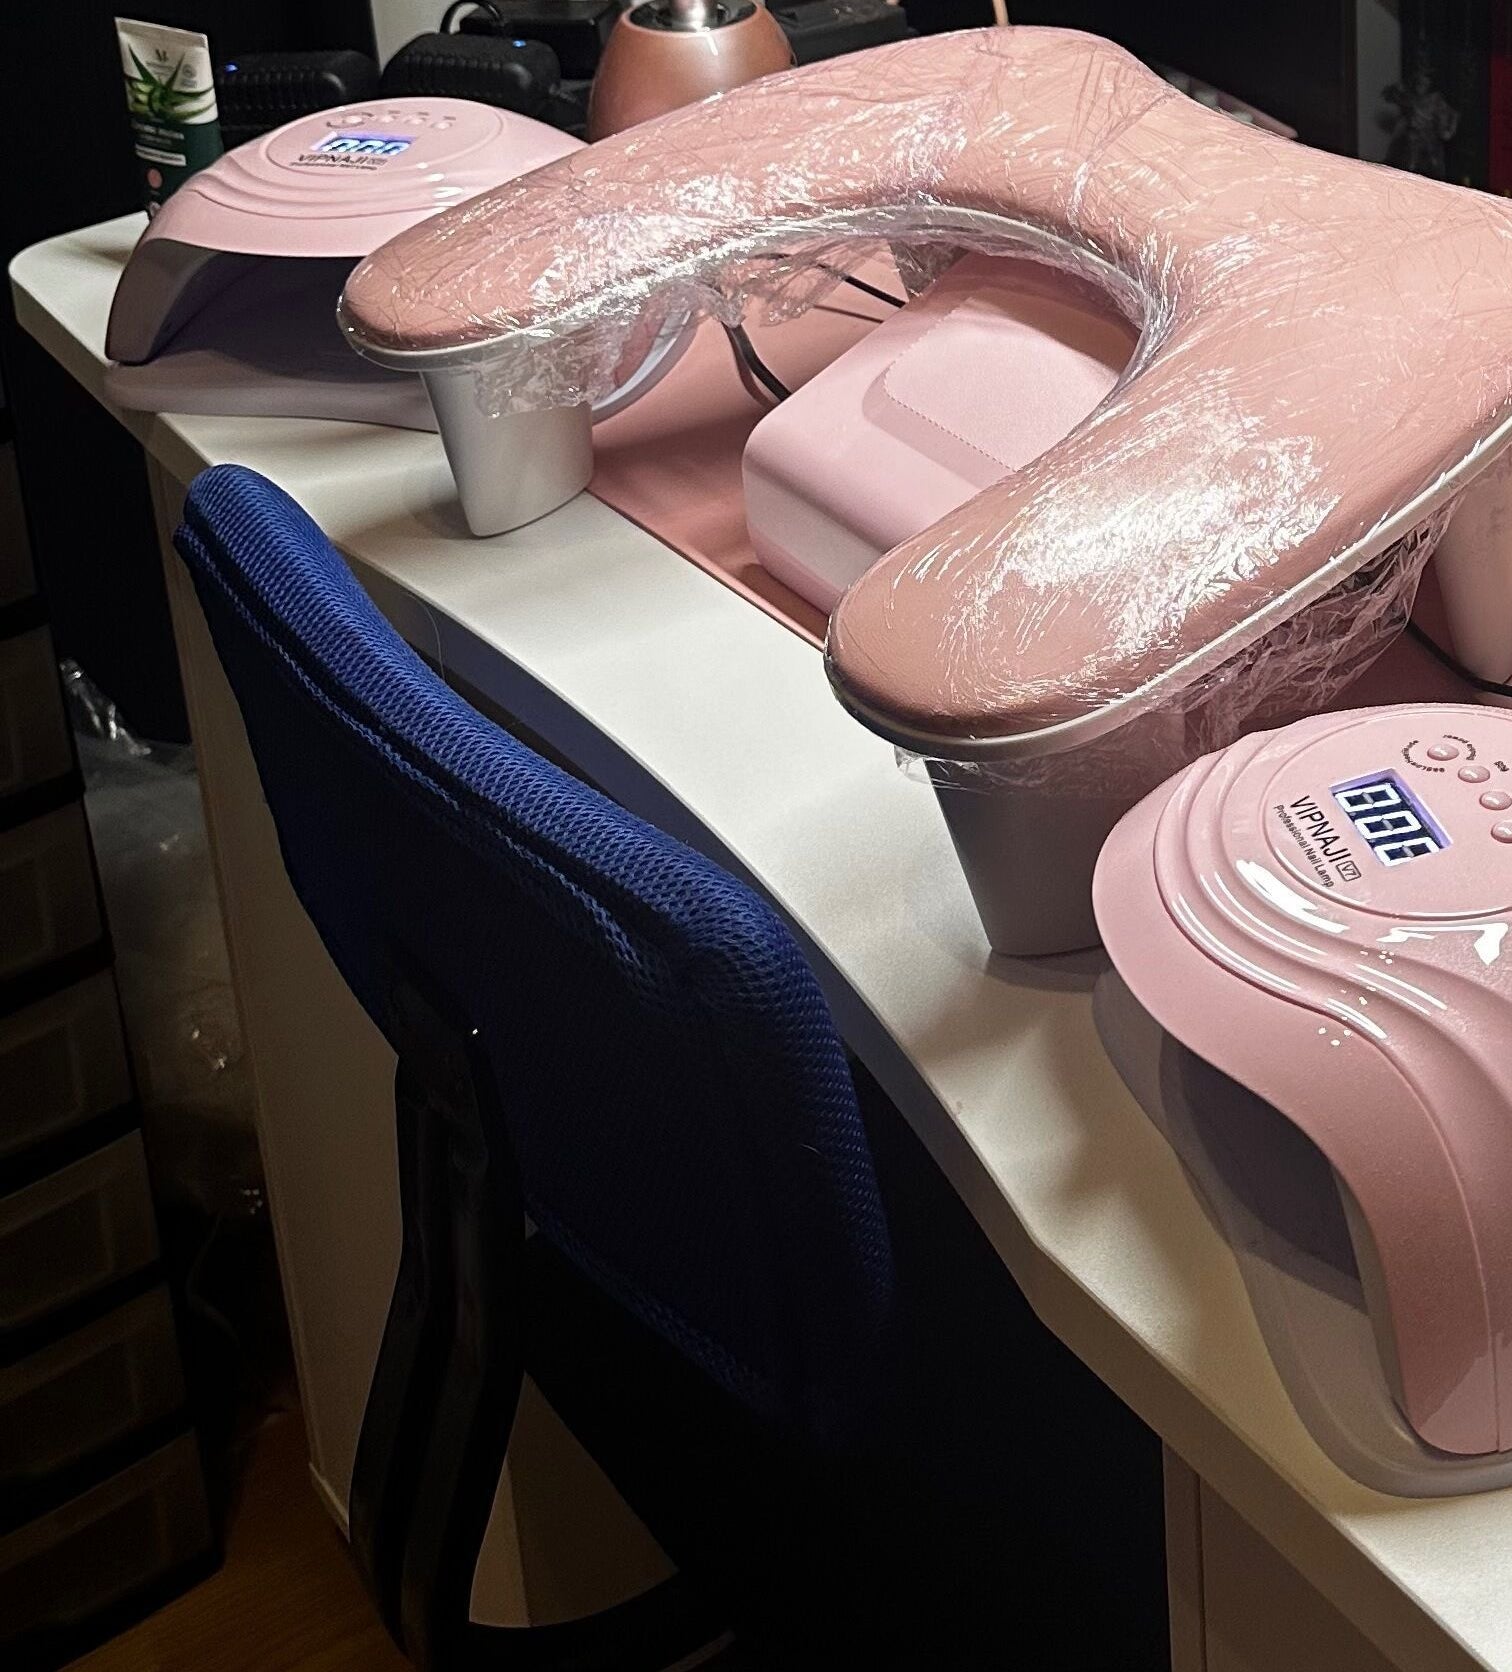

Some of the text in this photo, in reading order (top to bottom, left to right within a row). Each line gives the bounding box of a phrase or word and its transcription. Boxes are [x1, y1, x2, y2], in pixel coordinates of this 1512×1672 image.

[1274, 804, 1335, 888] Professional Nail Lamp
[1290, 795, 1352, 863] VIPNAJI
